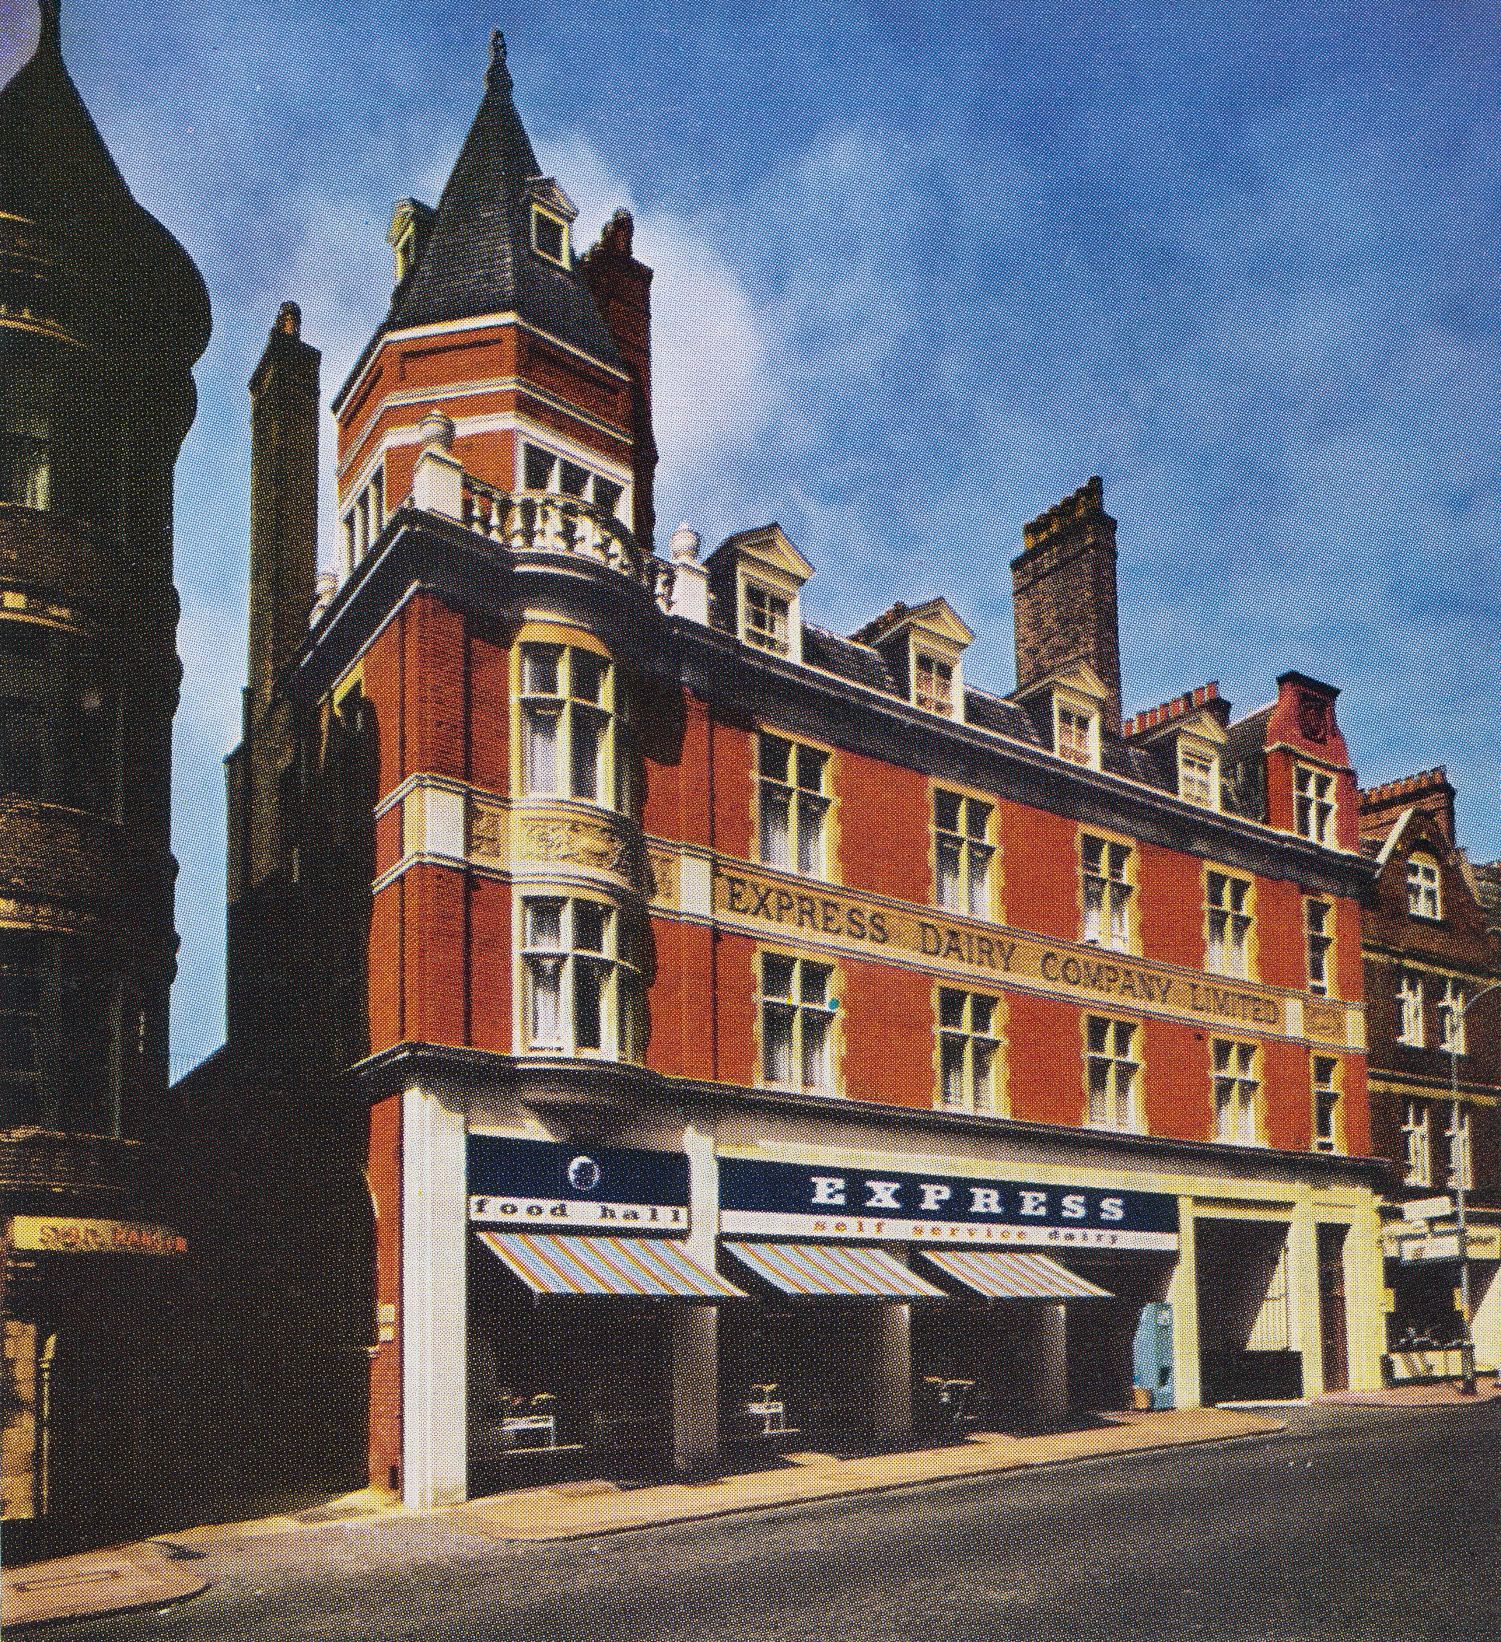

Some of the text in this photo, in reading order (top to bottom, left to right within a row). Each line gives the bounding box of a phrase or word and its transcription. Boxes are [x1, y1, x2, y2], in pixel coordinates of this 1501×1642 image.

[727, 877, 1278, 1024] EXPRESS DAIRY COMPANY LIMITED
[475, 1198, 682, 1223] food hall
[811, 1176, 1126, 1221] EXPRESS
[812, 1220, 1120, 1246] self service dairy
